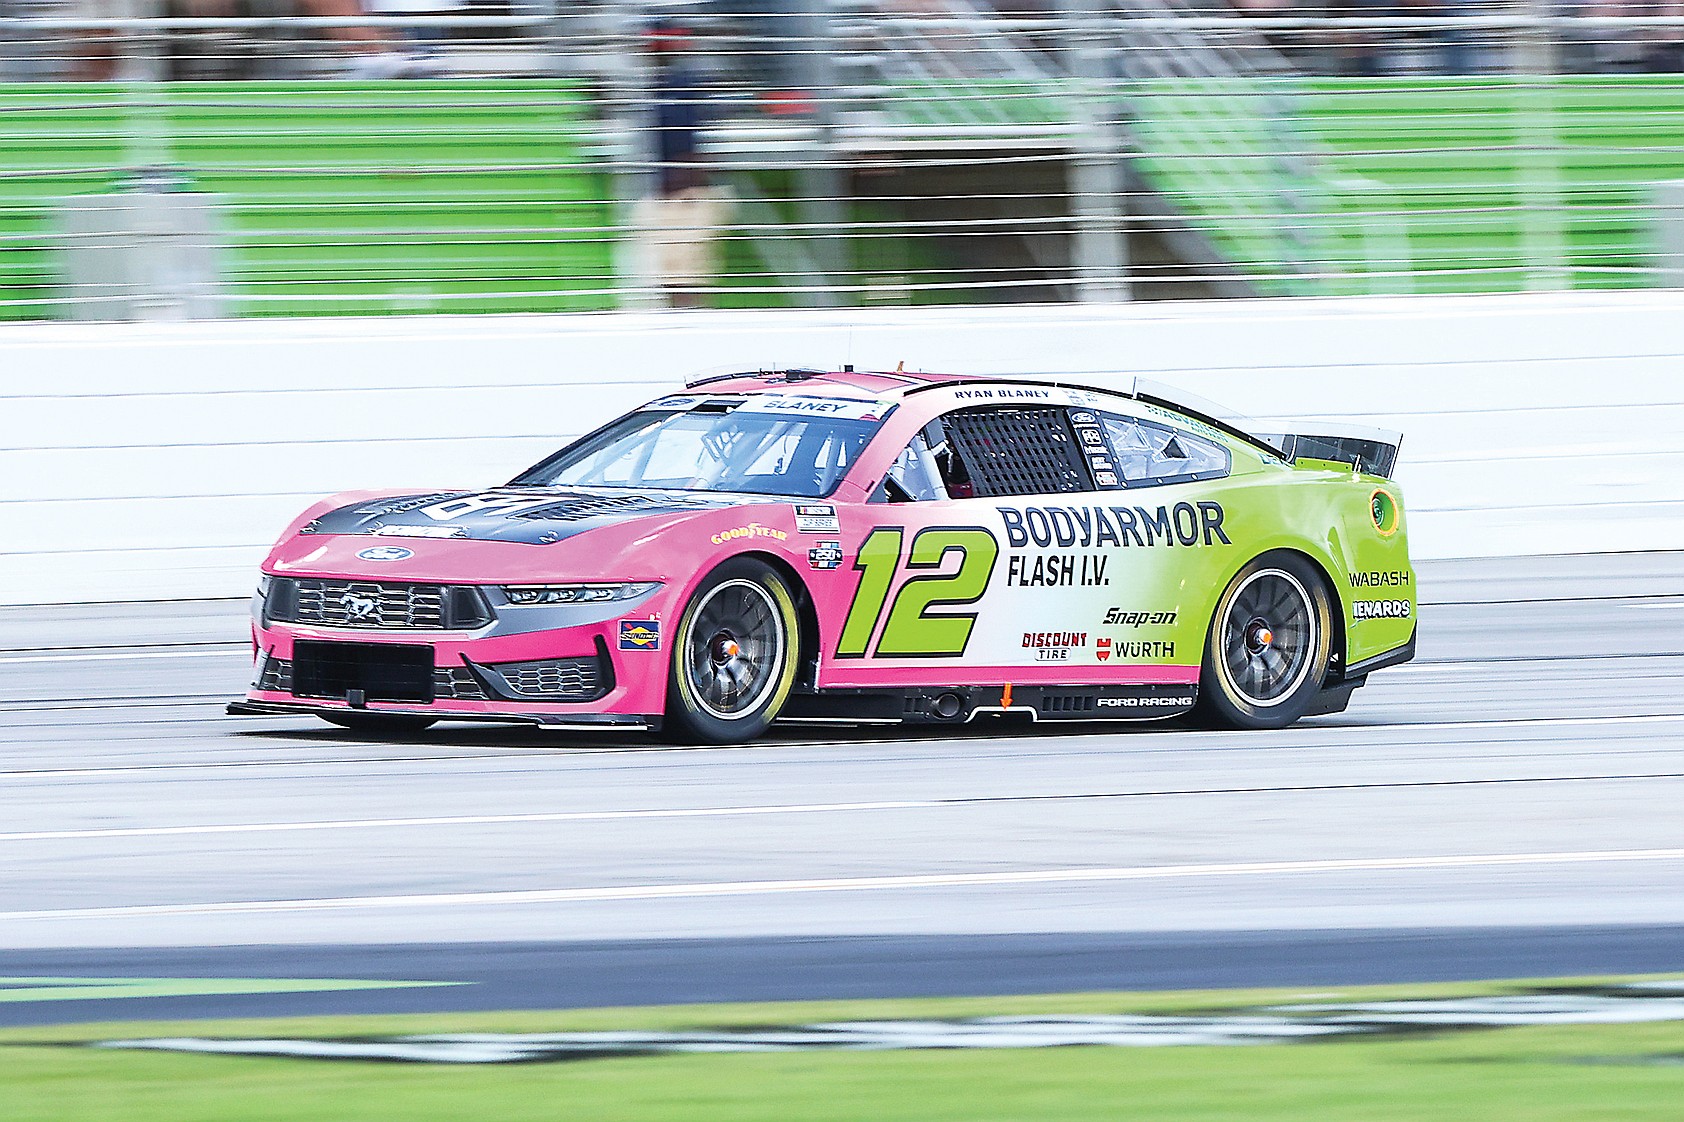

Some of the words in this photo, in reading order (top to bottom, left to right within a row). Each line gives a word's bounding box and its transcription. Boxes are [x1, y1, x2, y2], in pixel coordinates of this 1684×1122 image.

[954, 390, 993, 399] RYAN
[998, 389, 1050, 398] BLANEY
[763, 400, 849, 413] BLANEY
[996, 501, 1232, 548] BODYARMOR
[711, 522, 787, 545] GOODYEAR
[1007, 555, 1074, 587] FLASH
[1081, 555, 1110, 587] I.V.
[1349, 571, 1409, 587] WABASH
[834, 525, 999, 659] 12
[1102, 607, 1177, 628] Snap-on
[1022, 632, 1087, 647] DISCOUNT
[1039, 649, 1067, 659] TIRE
[1097, 697, 1137, 707] FORD
[1138, 697, 1193, 706] RACING
